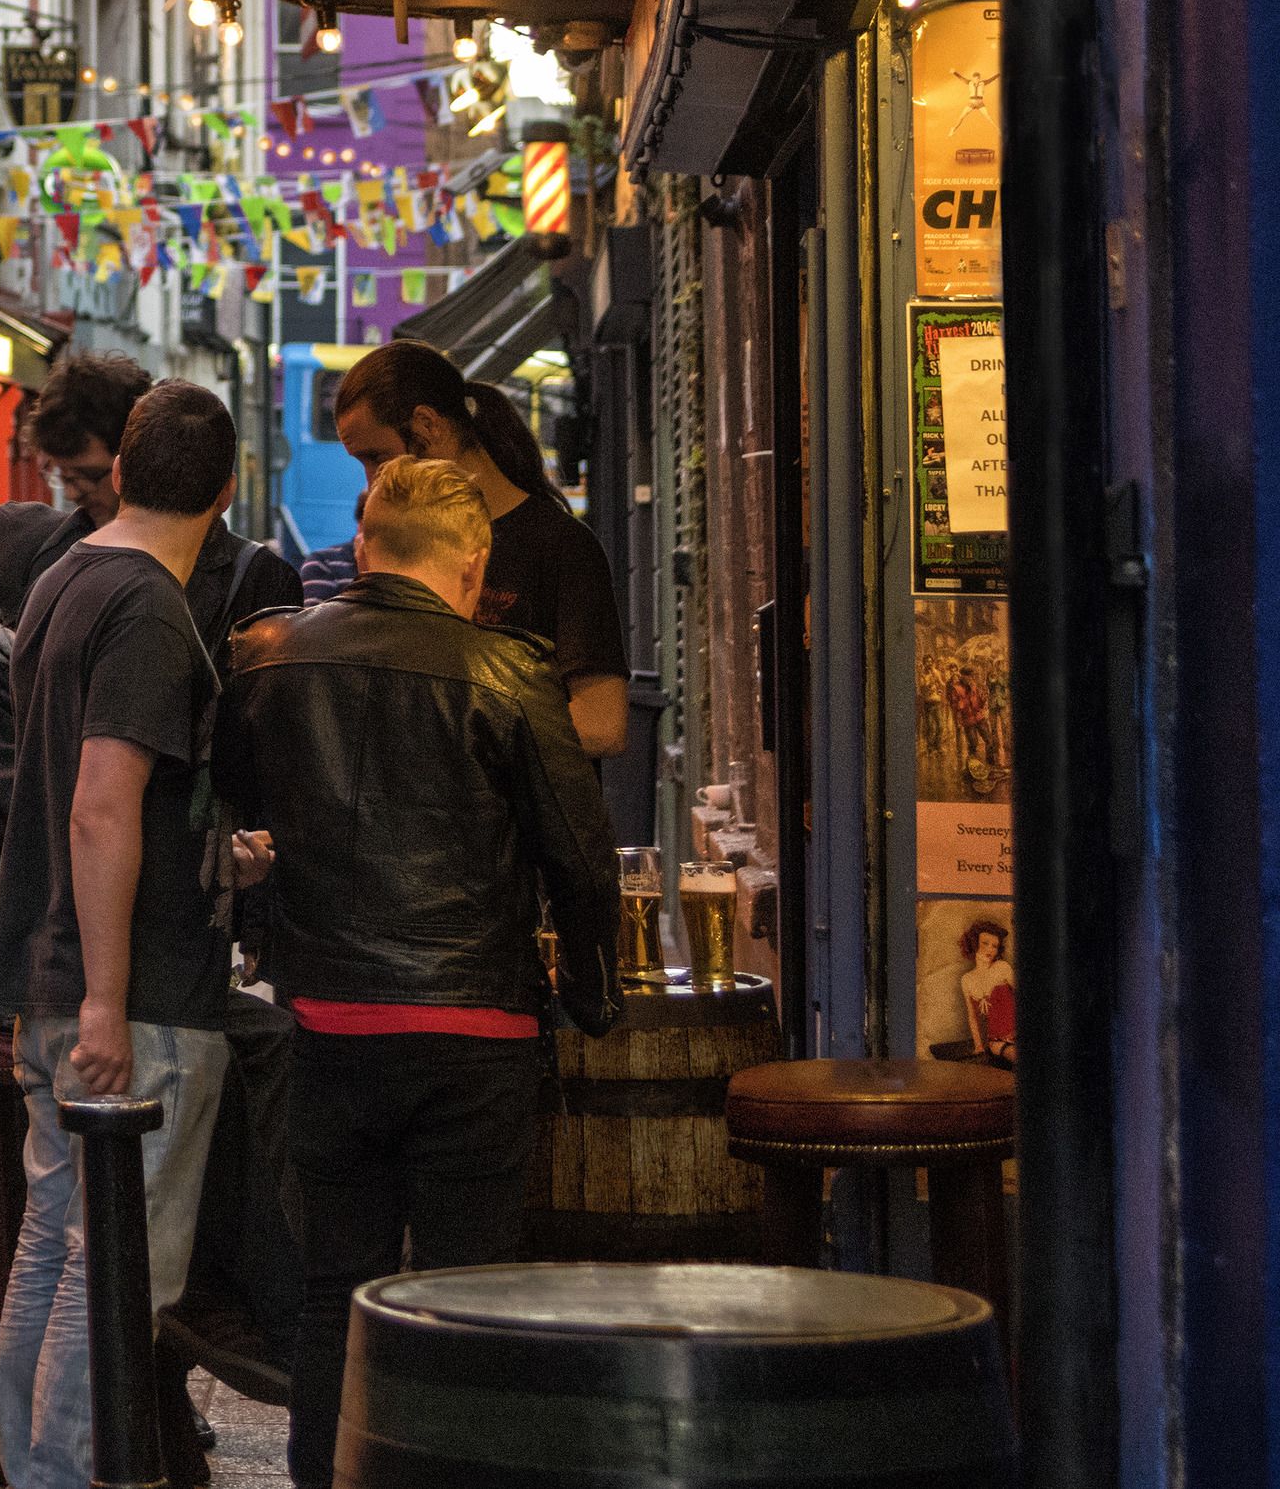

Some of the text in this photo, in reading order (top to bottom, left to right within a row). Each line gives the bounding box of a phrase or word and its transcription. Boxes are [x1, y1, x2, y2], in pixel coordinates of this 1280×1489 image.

[924, 321, 993, 341] Harvest 2014
[957, 823, 1010, 839] Sweeney
[957, 860, 993, 875] Every
